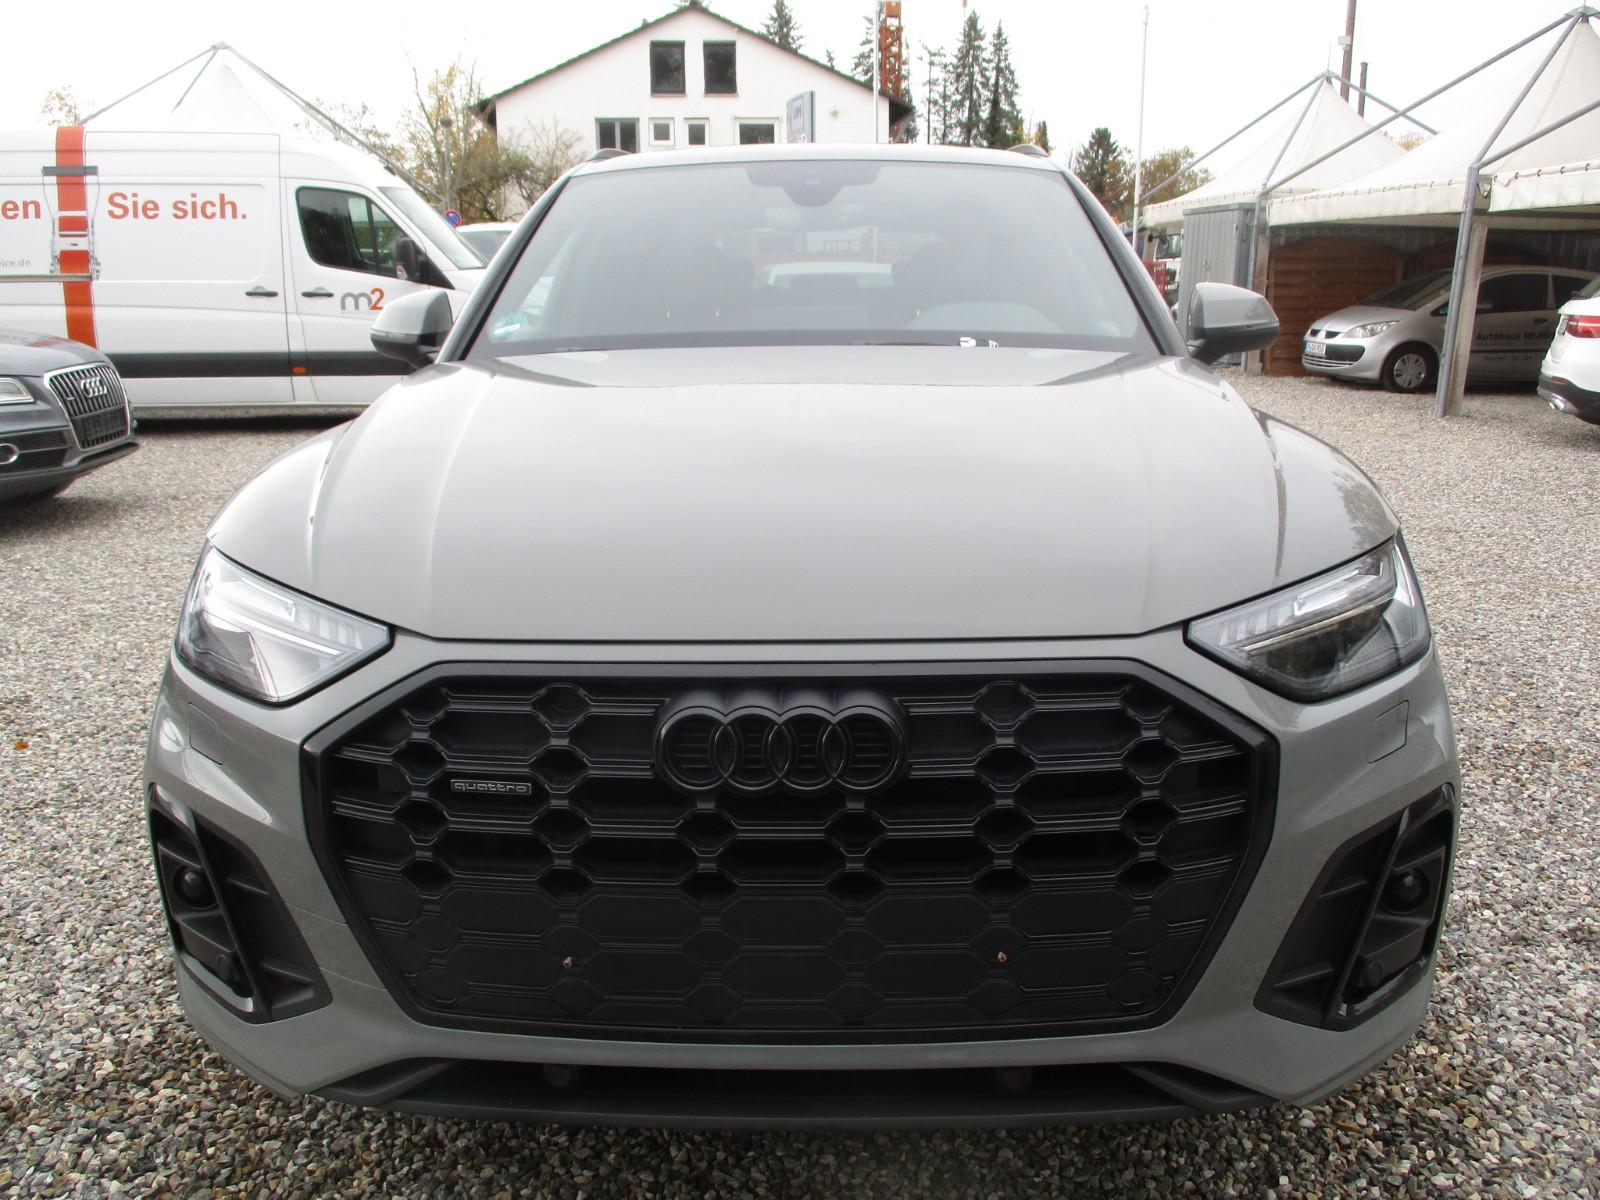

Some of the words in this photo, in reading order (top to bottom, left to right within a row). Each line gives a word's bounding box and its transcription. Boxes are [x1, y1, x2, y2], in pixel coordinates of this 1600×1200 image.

[107, 192, 160, 220] Sie
[172, 193, 247, 220] sich.
[340, 287, 385, 310] m2
[1477, 331, 1520, 340] Autohaus
[454, 782, 528, 793] quattro
